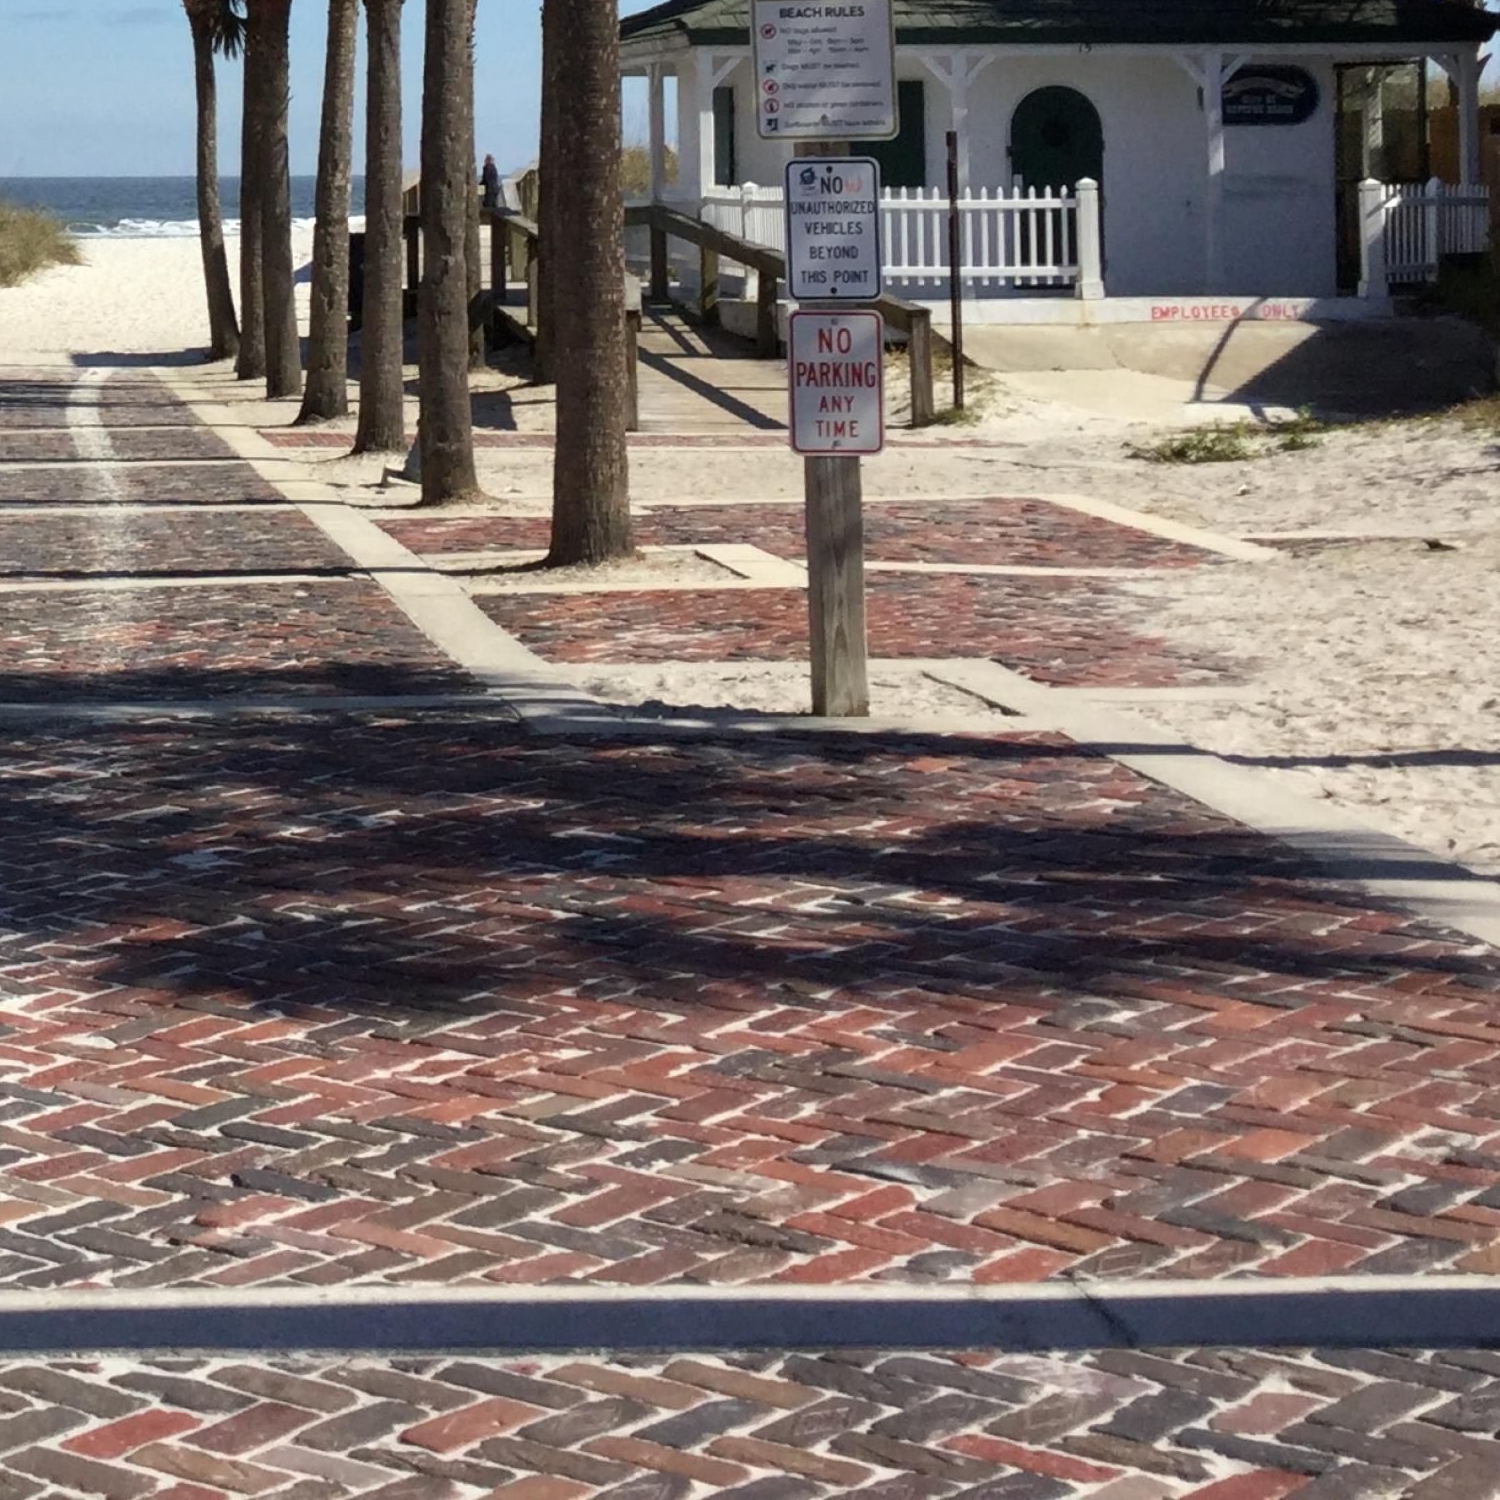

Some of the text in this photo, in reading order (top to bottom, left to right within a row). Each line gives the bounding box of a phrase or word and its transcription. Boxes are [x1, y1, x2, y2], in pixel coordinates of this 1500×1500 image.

[779, 6, 865, 18] BEACH RULES
[820, 176, 843, 195] NO
[791, 201, 875, 215] UNAUTHORIZED
[804, 221, 863, 235] VEHICLES
[809, 245, 859, 260] BEYOND
[801, 269, 869, 284] THIS POINT
[1151, 304, 1301, 320] EMPLOYEES ONLY
[818, 328, 852, 354] NO
[796, 361, 876, 388] PARKING
[818, 395, 855, 413] ANY
[815, 420, 860, 438] TIME
